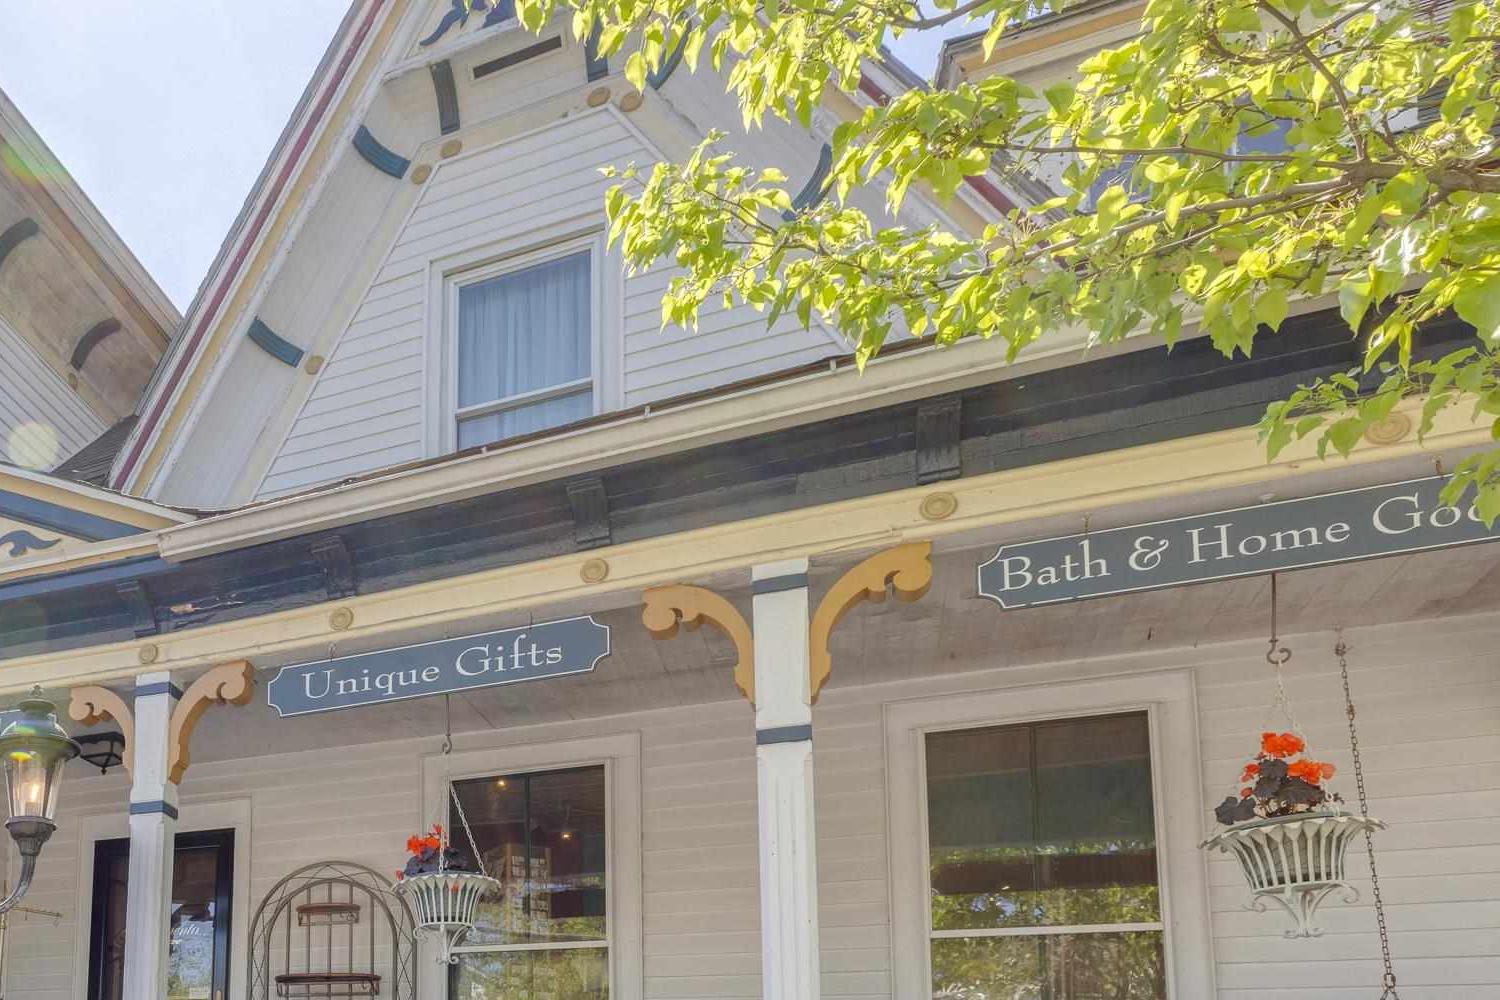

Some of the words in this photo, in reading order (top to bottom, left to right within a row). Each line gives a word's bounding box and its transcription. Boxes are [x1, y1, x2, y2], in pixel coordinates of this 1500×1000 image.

[998, 540, 1111, 591] Bath
[1128, 535, 1170, 571] &
[1185, 520, 1351, 565] Home
[301, 665, 440, 699] Unique
[454, 633, 562, 676] Gifts
